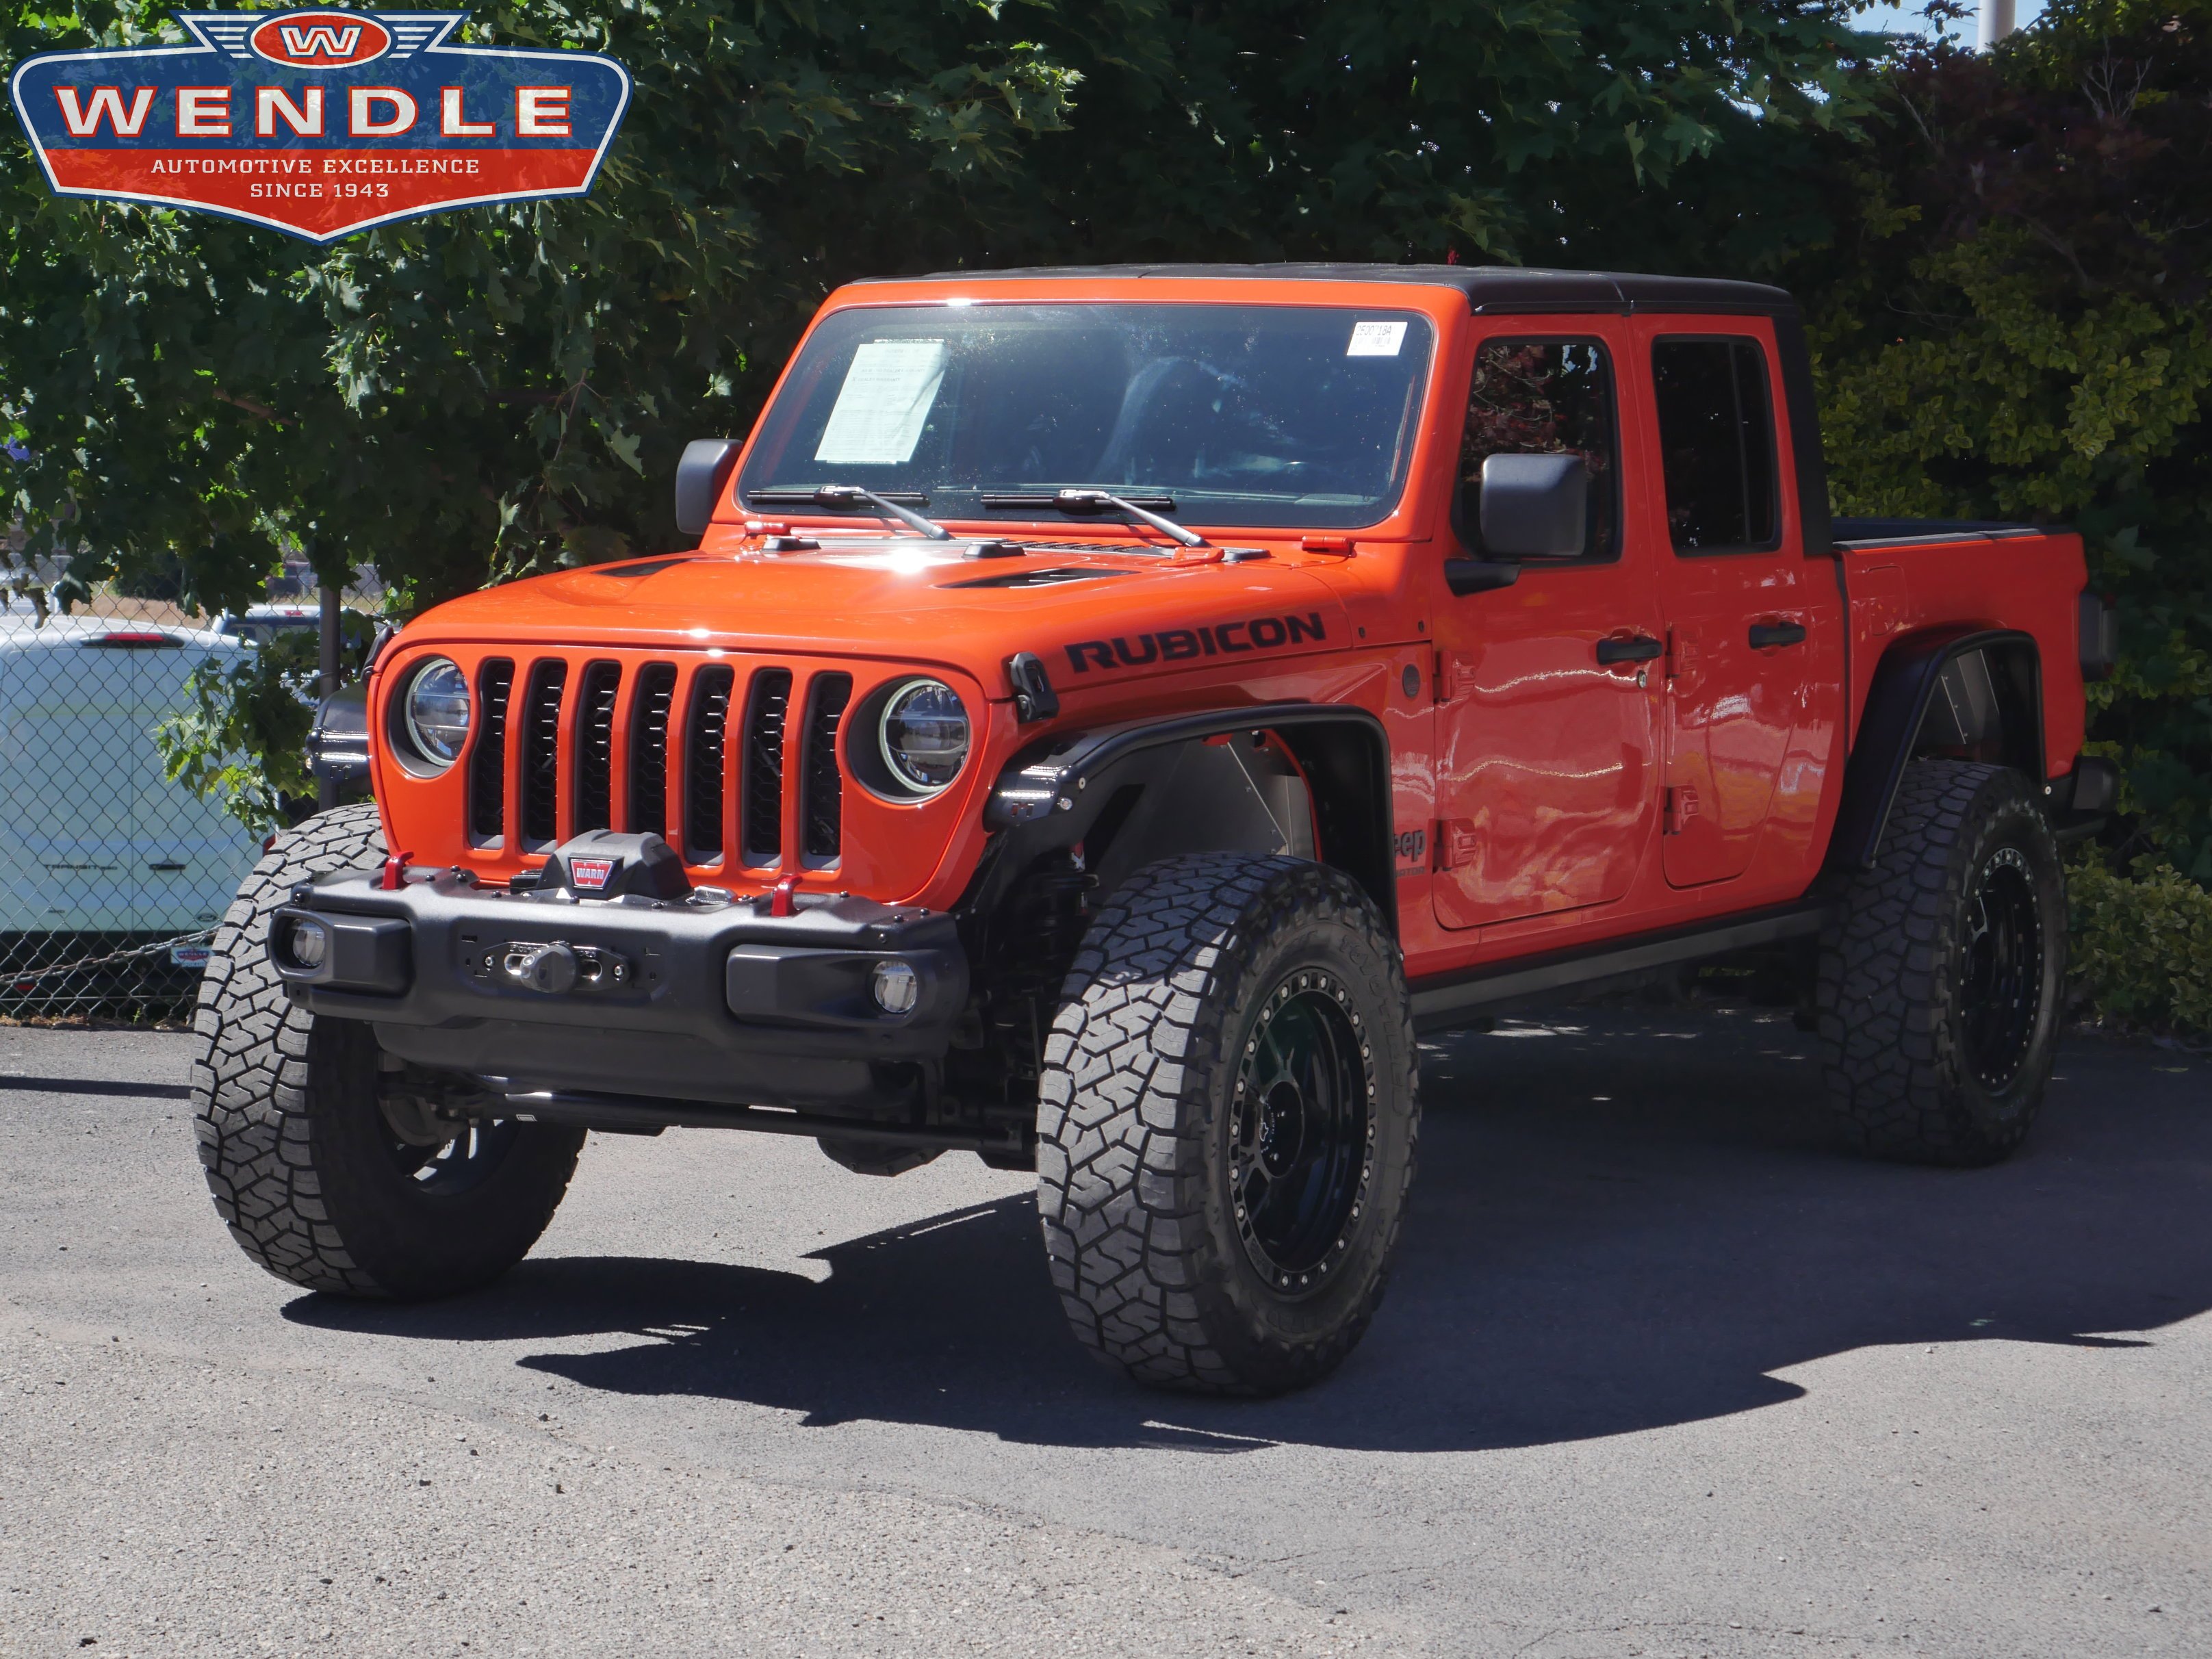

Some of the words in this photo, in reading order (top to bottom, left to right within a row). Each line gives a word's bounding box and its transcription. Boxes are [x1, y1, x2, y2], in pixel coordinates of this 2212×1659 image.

[1064, 612, 1326, 674] RUBICON
[1393, 830, 1426, 862] eep
[576, 867, 604, 879] WARN
